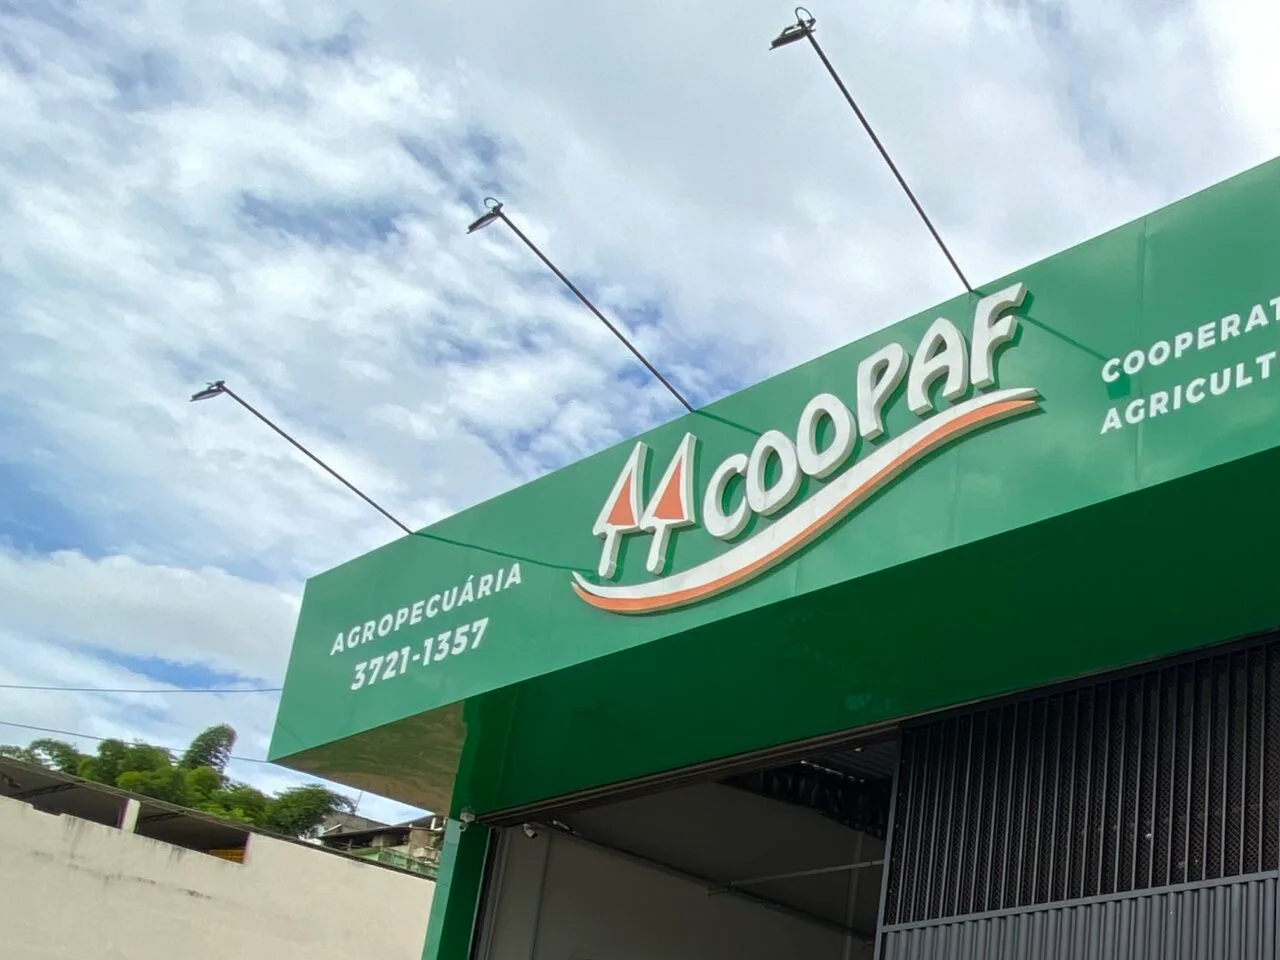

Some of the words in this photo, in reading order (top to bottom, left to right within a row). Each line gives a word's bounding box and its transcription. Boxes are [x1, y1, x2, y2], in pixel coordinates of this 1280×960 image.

[703, 282, 1028, 541] COOPAF
[329, 562, 522, 656] AGROPECUÁRIA
[351, 617, 489, 690] 3721-1357
